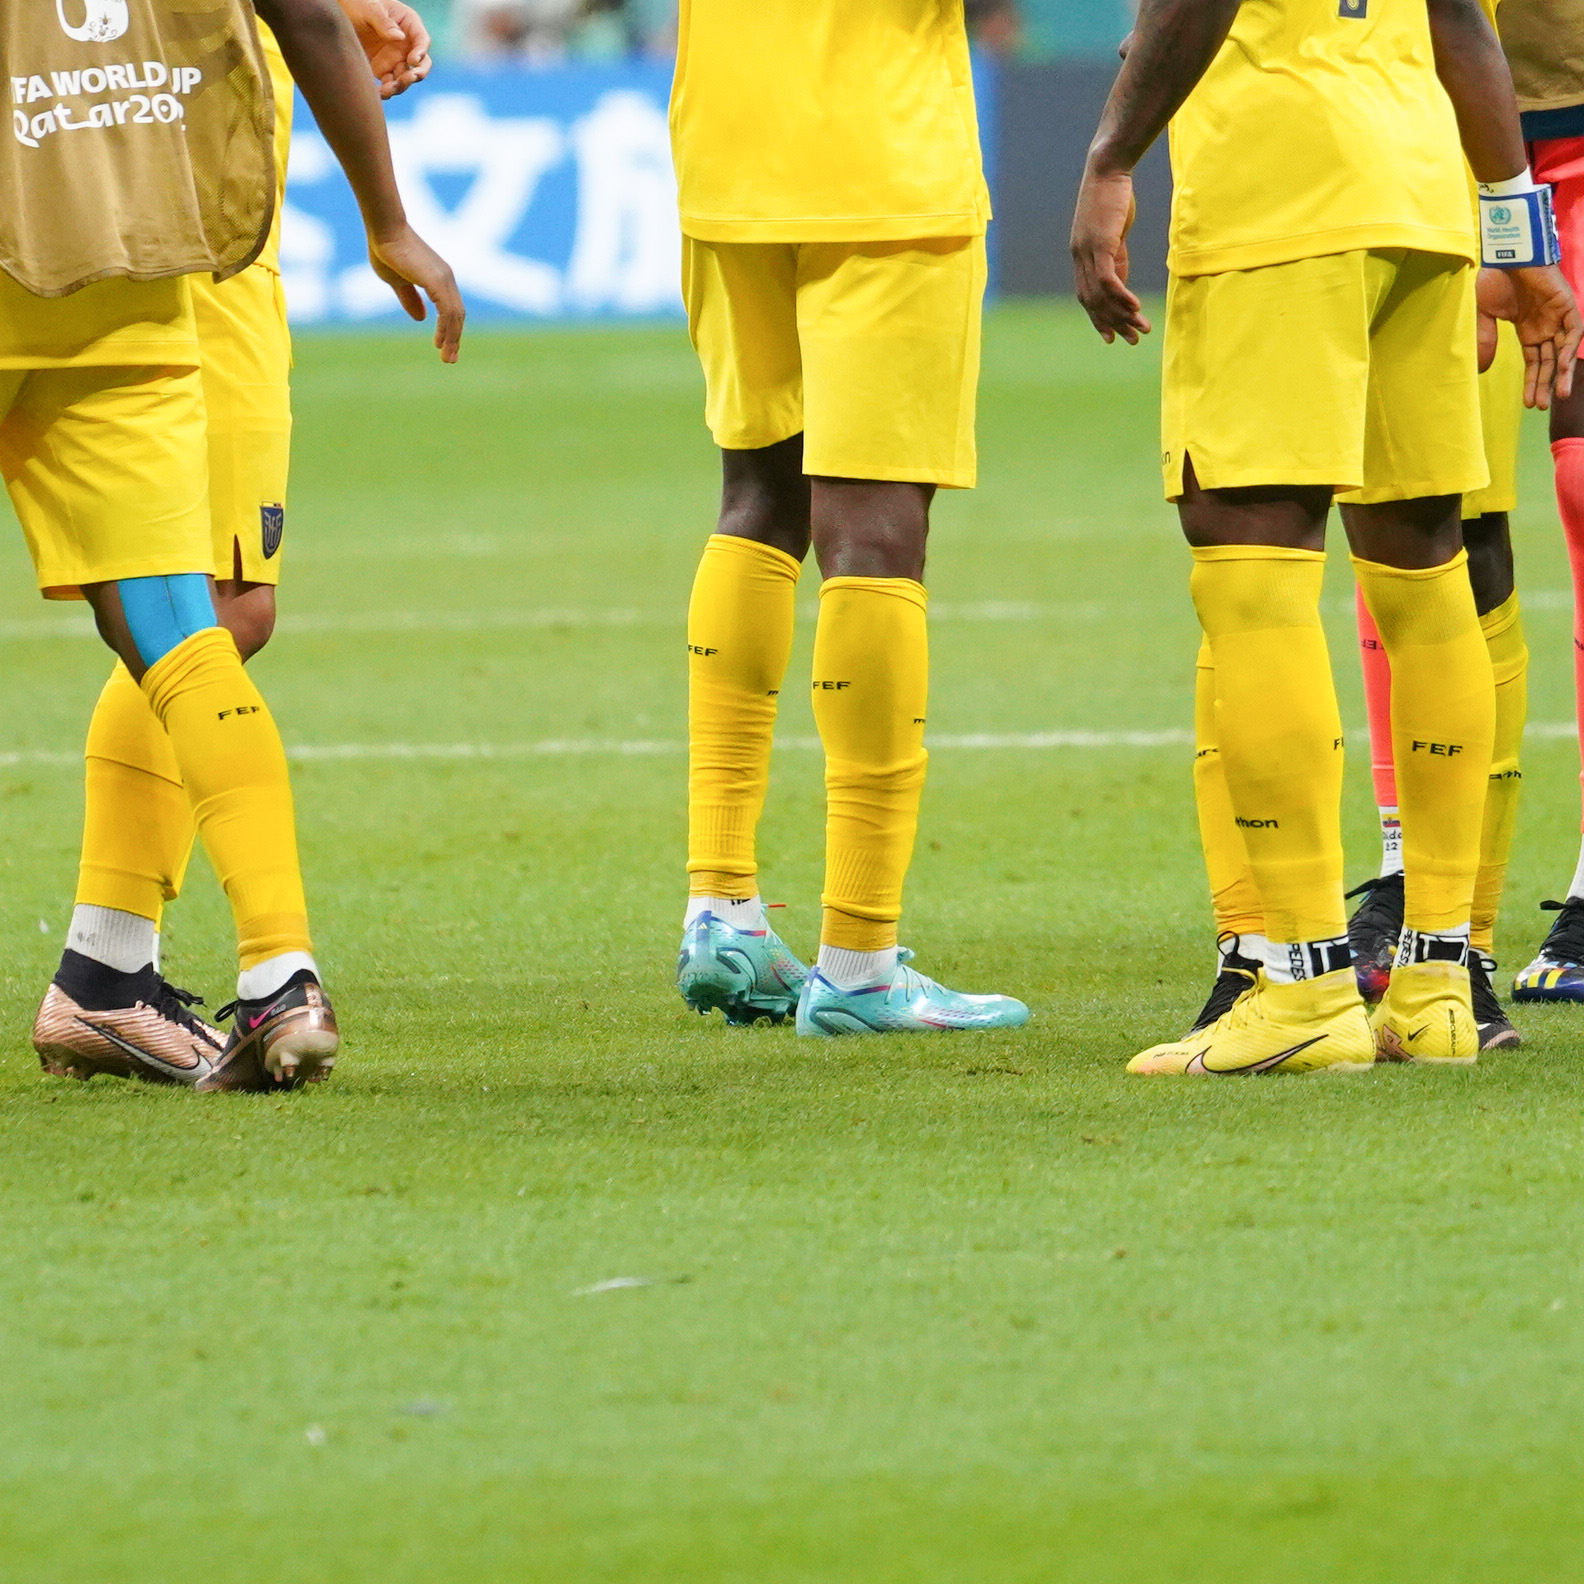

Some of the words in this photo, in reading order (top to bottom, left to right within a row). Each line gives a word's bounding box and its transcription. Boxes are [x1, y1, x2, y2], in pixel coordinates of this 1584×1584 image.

[50, 60, 168, 98] WORLD
[13, 92, 186, 149] Qatar20
[812, 680, 852, 691] FEF
[1411, 739, 1464, 758] FEF
